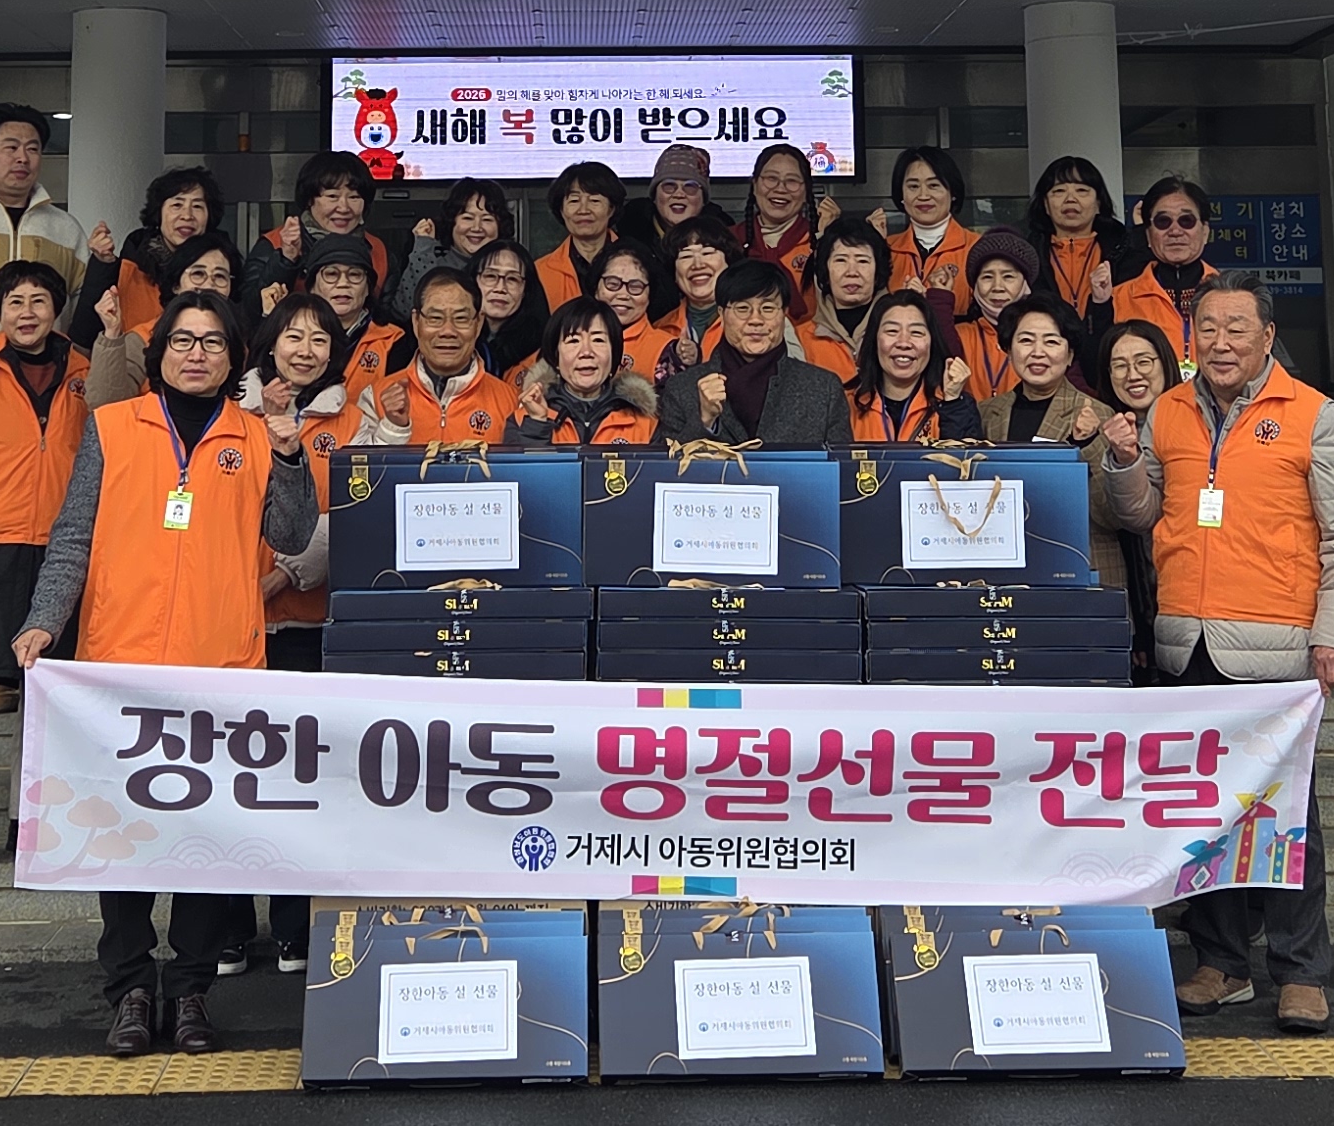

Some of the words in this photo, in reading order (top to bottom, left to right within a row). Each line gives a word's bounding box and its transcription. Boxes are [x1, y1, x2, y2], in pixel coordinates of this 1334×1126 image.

[456, 89, 486, 100] 2026
[544, 89, 565, 101] 맞아
[601, 89, 643, 101] 나아가는
[411, 107, 486, 145] 새해
[500, 108, 536, 145] 복
[550, 107, 623, 144] 많이
[638, 107, 789, 144] 받으세요
[1270, 201, 1305, 220] 설치
[1270, 223, 1307, 241] 장소
[1272, 244, 1308, 263] 안내
[413, 503, 458, 517] 장한아동
[464, 503, 474, 516] 설
[480, 502, 503, 515] 선물
[672, 505, 717, 519] 장한아동
[723, 505, 733, 519] 설
[740, 506, 763, 519] 선물
[116, 707, 330, 812] 장한
[357, 719, 560, 813] 아동
[588, 726, 1001, 823] 명절선물
[1028, 729, 1231, 830] 전달
[565, 833, 650, 867] 거제시
[658, 835, 855, 871] 아동위원협의회
[398, 986, 448, 1001] 장한아동
[455, 985, 466, 1001] 설
[473, 984, 498, 999] 선물
[694, 981, 744, 997] 장한아동
[749, 980, 761, 996] 설
[767, 979, 792, 995] 선물
[985, 977, 1035, 993] 장한아동
[1041, 977, 1053, 992] 설
[1059, 977, 1084, 992] 선물
